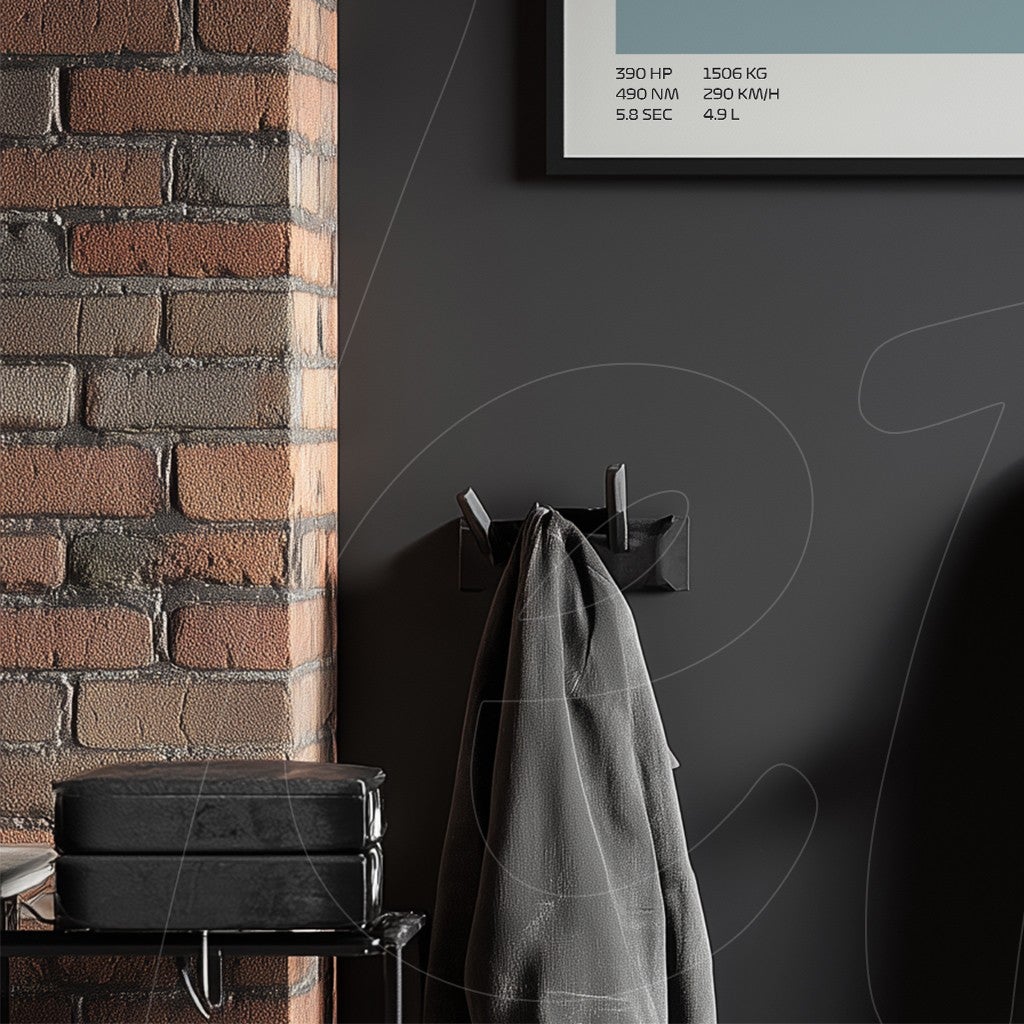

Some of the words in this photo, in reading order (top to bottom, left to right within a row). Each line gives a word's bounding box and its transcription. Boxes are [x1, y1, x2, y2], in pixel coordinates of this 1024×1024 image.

[615, 67, 647, 80] 390
[649, 67, 673, 80] HP
[702, 67, 743, 80] 1506
[746, 67, 768, 80] KG
[615, 87, 648, 101] 490
[651, 87, 680, 101] NM
[702, 87, 734, 101] 290
[737, 87, 780, 102] KM/H
[615, 108, 639, 121] 5.8
[642, 108, 673, 121] SEC
[702, 108, 728, 121] 4.9
[730, 107, 740, 121] L
